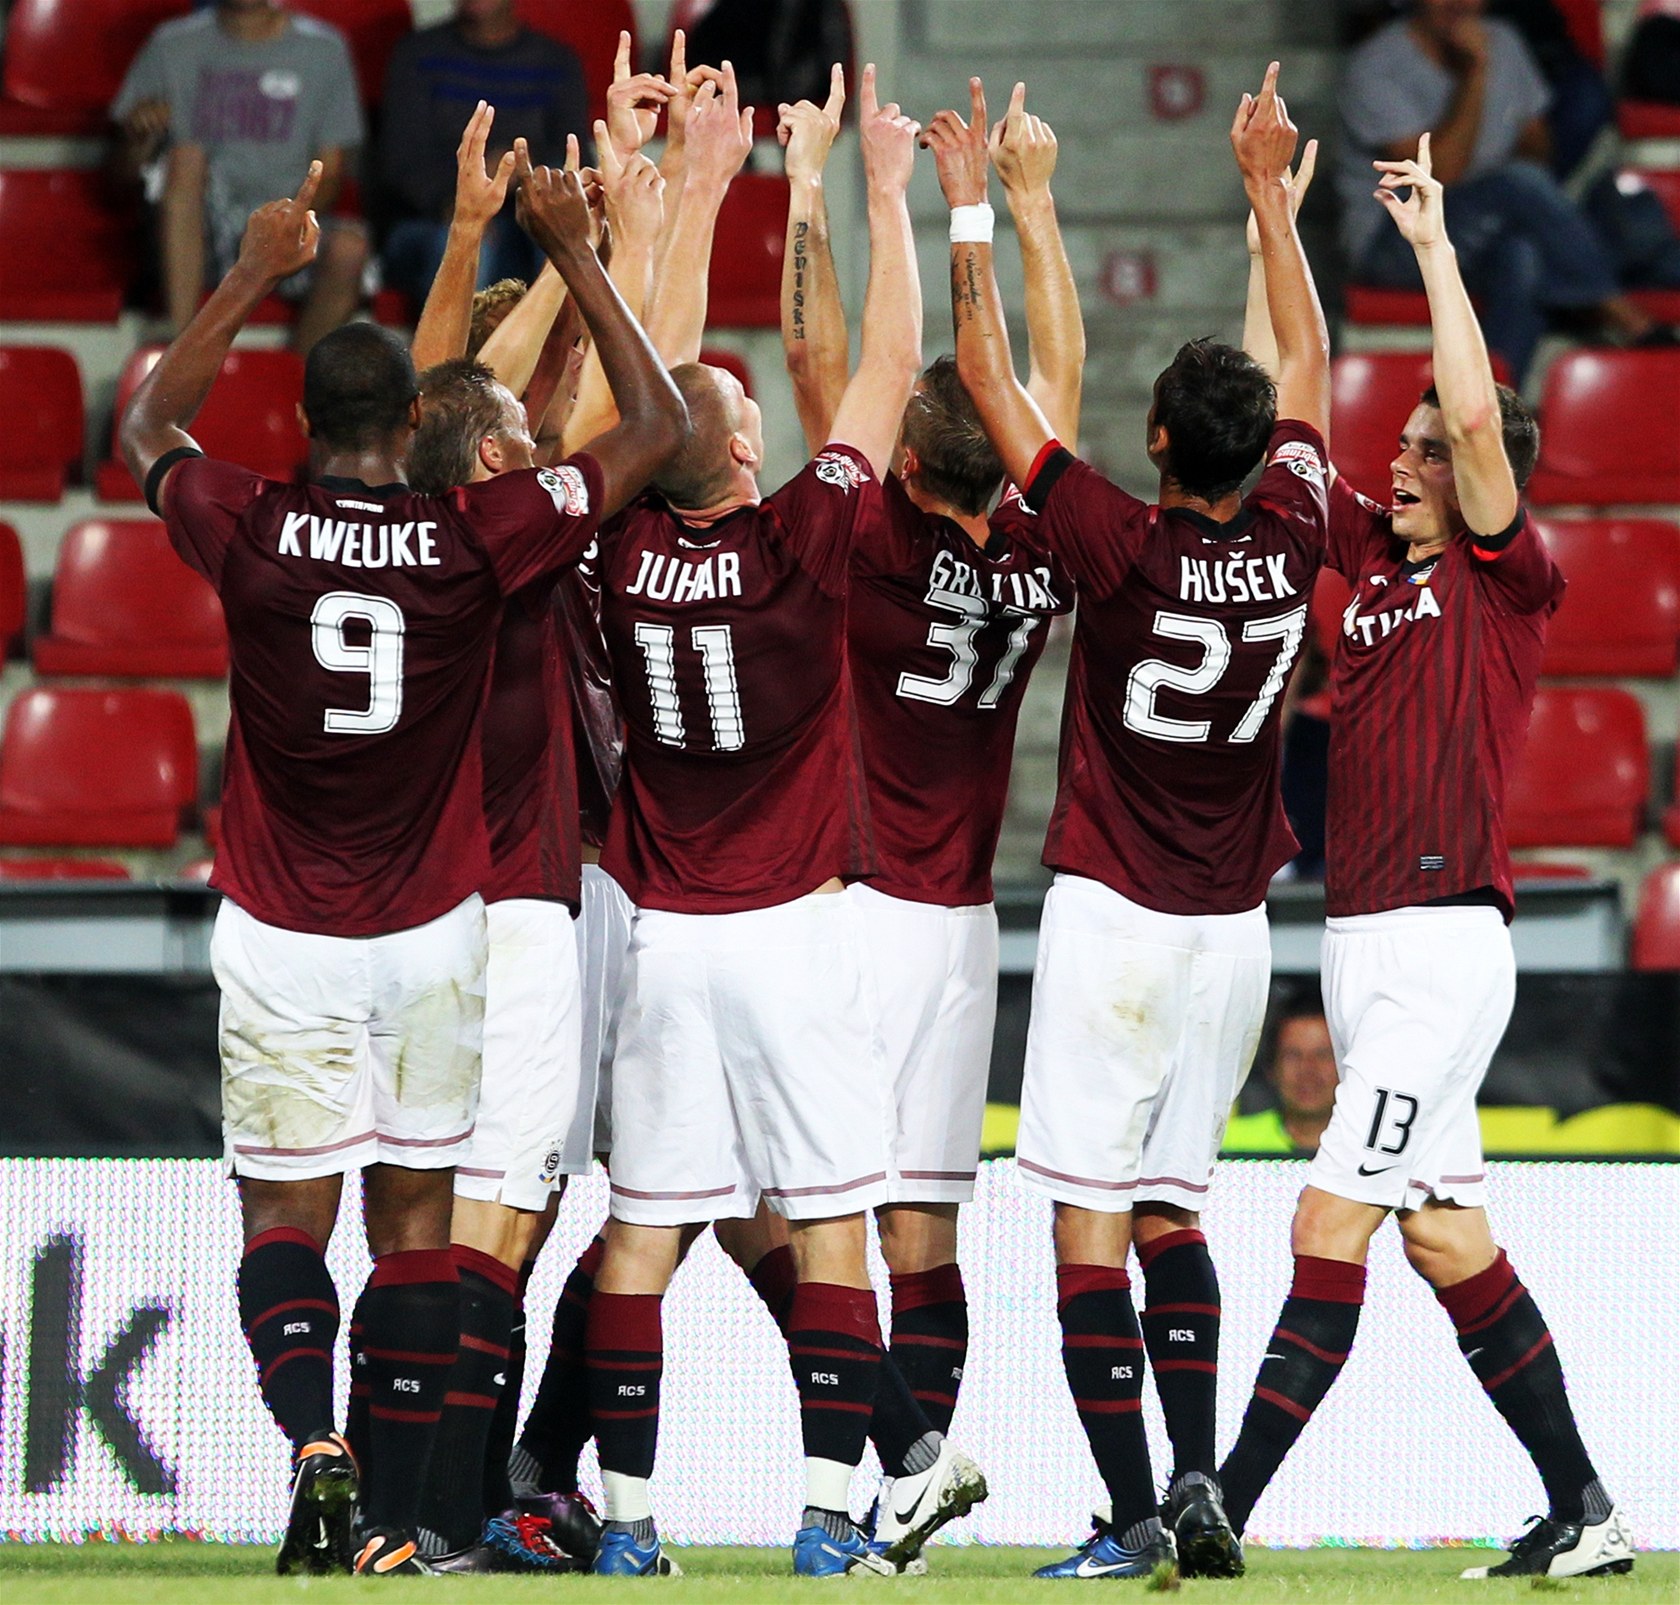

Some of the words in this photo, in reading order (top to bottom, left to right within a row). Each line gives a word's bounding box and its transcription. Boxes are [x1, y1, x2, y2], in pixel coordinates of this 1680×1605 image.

[278, 511, 441, 568] KWEUKE
[626, 549, 743, 602] JUHAR
[1179, 551, 1298, 603] HUŠEK
[310, 591, 406, 735] 9
[634, 622, 745, 753] 11
[1123, 603, 1307, 743] 27
[1364, 1086, 1419, 1156] 13
[24, 1233, 178, 1494] k
